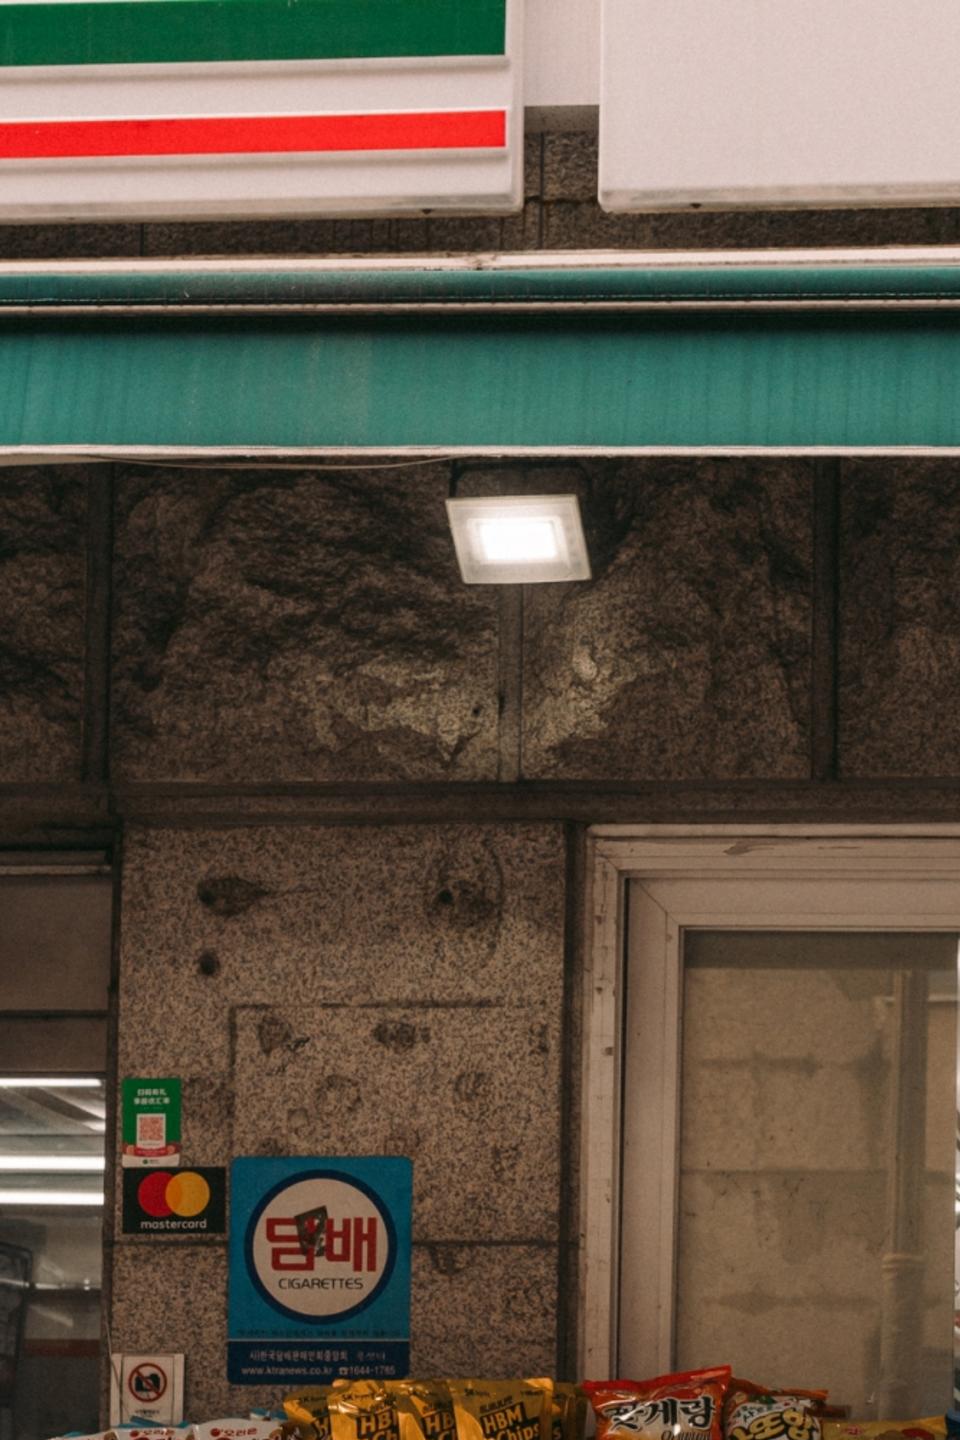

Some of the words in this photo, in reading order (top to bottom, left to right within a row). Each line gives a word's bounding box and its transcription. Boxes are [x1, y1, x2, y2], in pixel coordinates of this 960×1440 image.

[140, 1218, 207, 1230] mastercard
[279, 1278, 363, 1290] CIGARETTES
[483, 1405, 522, 1434] HBM
[603, 1396, 715, 1429] 꽃게랑
